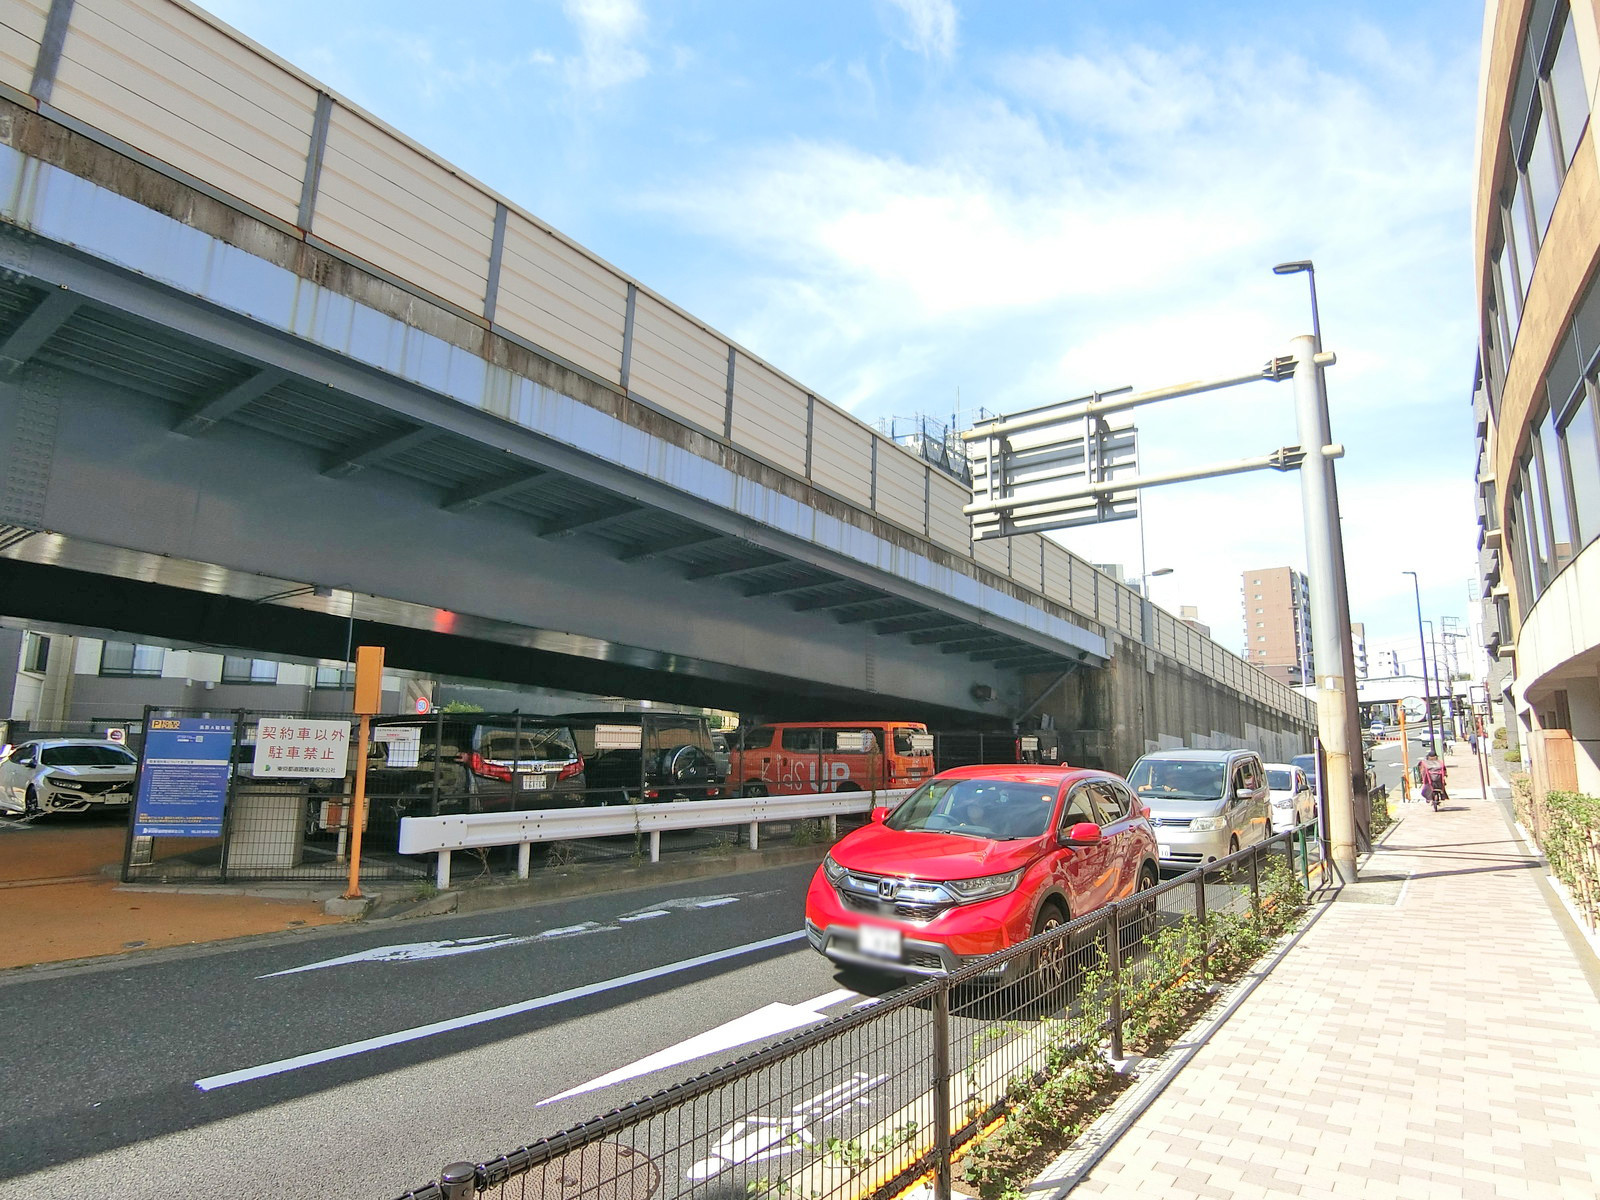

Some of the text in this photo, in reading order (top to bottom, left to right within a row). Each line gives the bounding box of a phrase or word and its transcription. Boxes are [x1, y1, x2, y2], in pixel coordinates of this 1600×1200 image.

[262, 726, 345, 741] 契約車以外
[268, 745, 335, 760] 駐車禁止
[809, 762, 850, 792] UP
